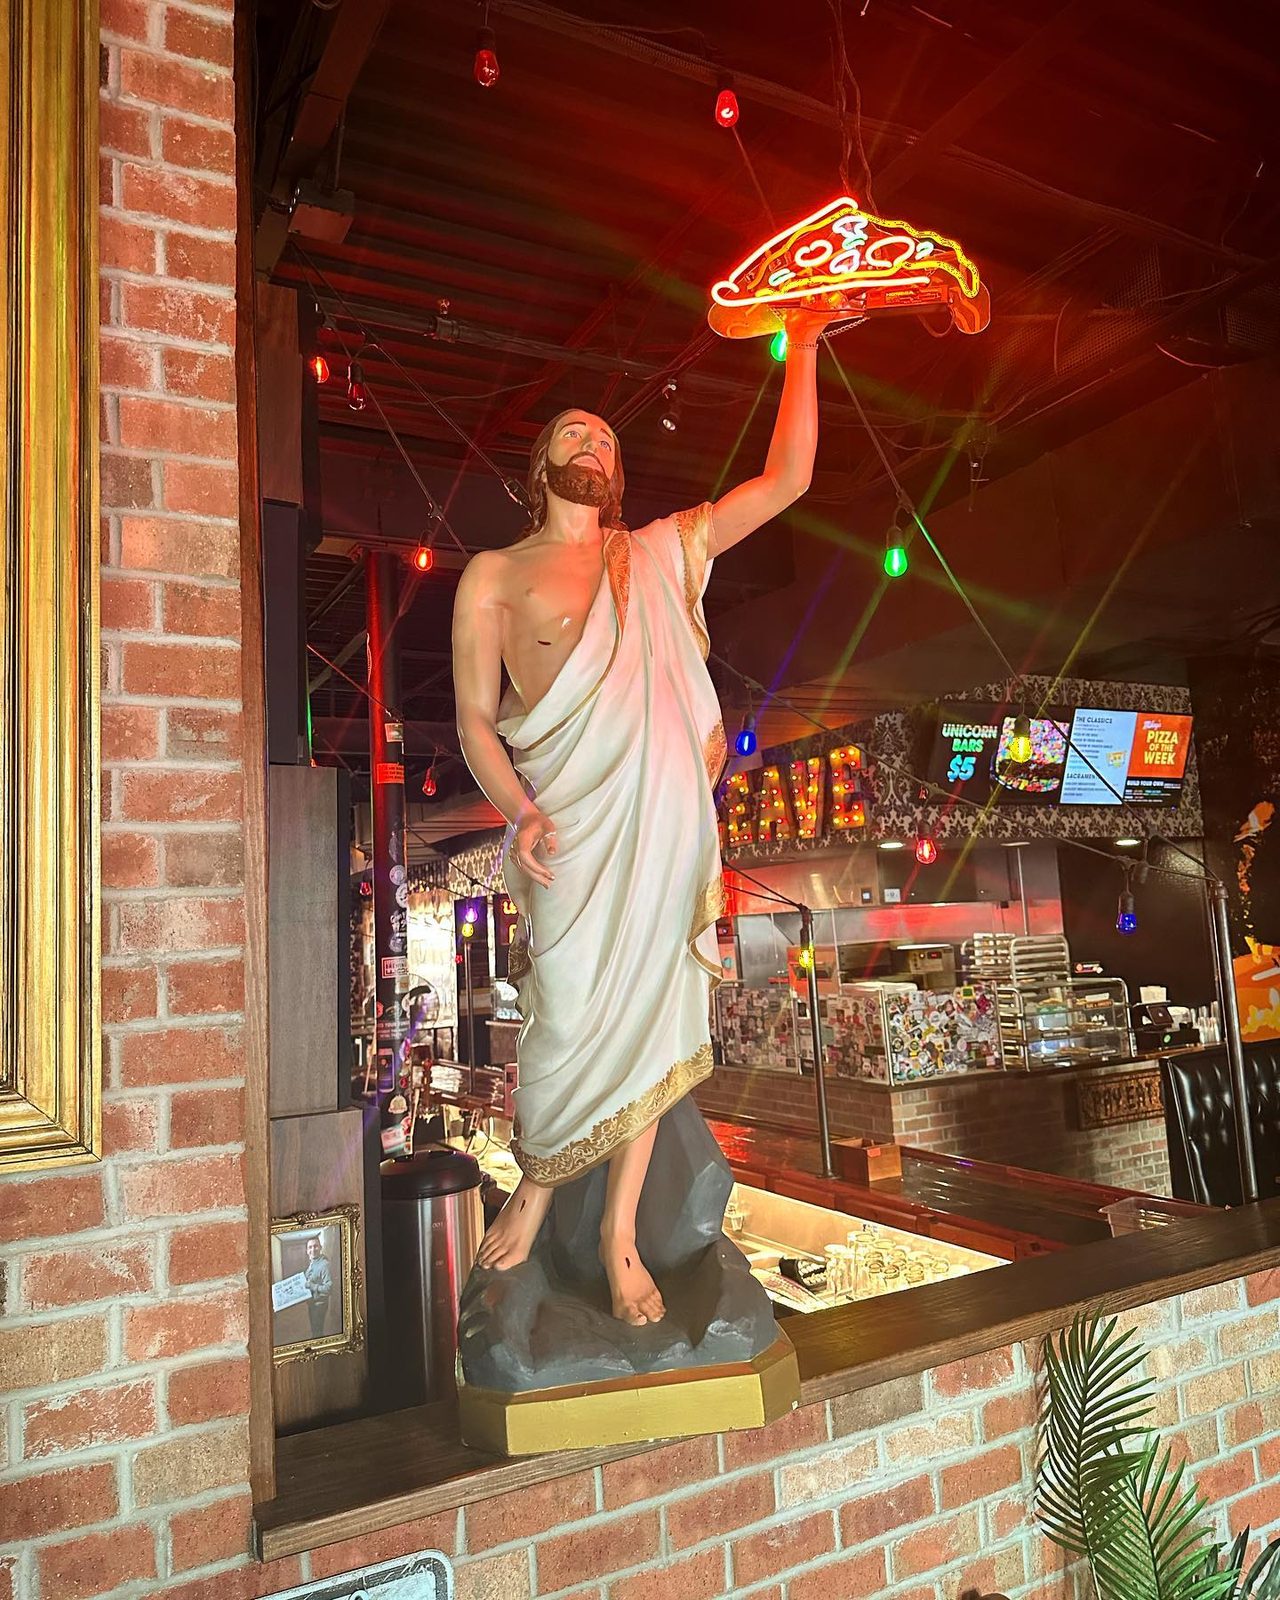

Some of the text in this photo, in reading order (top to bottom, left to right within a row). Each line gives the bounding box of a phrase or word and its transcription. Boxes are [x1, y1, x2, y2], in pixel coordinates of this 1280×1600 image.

[941, 723, 998, 739] UNICORN
[1146, 730, 1178, 744] PIZZA
[952, 738, 984, 753] BARS
[1149, 743, 1175, 752] OF THE
[1144, 751, 1176, 765] WEEK
[947, 754, 977, 782] $5
